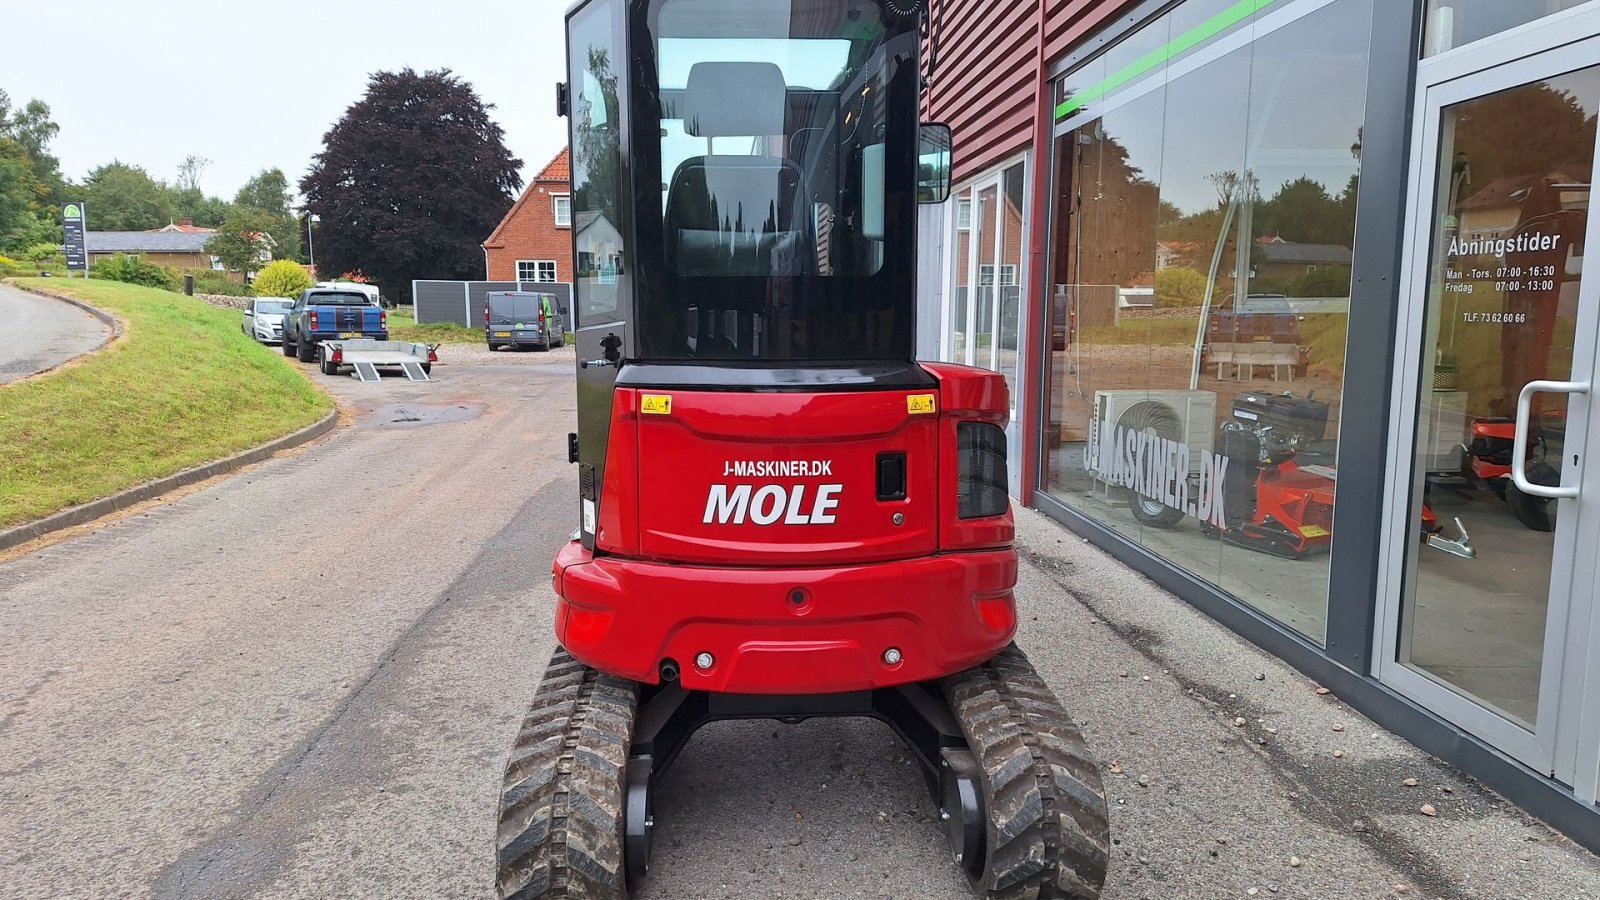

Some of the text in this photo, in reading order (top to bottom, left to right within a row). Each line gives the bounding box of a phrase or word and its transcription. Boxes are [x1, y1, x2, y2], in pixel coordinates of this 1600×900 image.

[1447, 232, 1561, 257] Åbningstider
[1446, 270, 1463, 279] Man
[1496, 267, 1521, 278] 07:00
[1528, 265, 1555, 276] 16:30
[1445, 283, 1473, 294] Fredag
[1495, 281, 1520, 291] 07:00
[1527, 280, 1553, 291] 13:00
[1463, 313, 1526, 323] TLF. 73 62 60 66
[723, 460, 832, 476] J-MASKINER.DK
[1083, 418, 1229, 530] J-MASKINER.DK
[702, 484, 843, 525] MOLE
